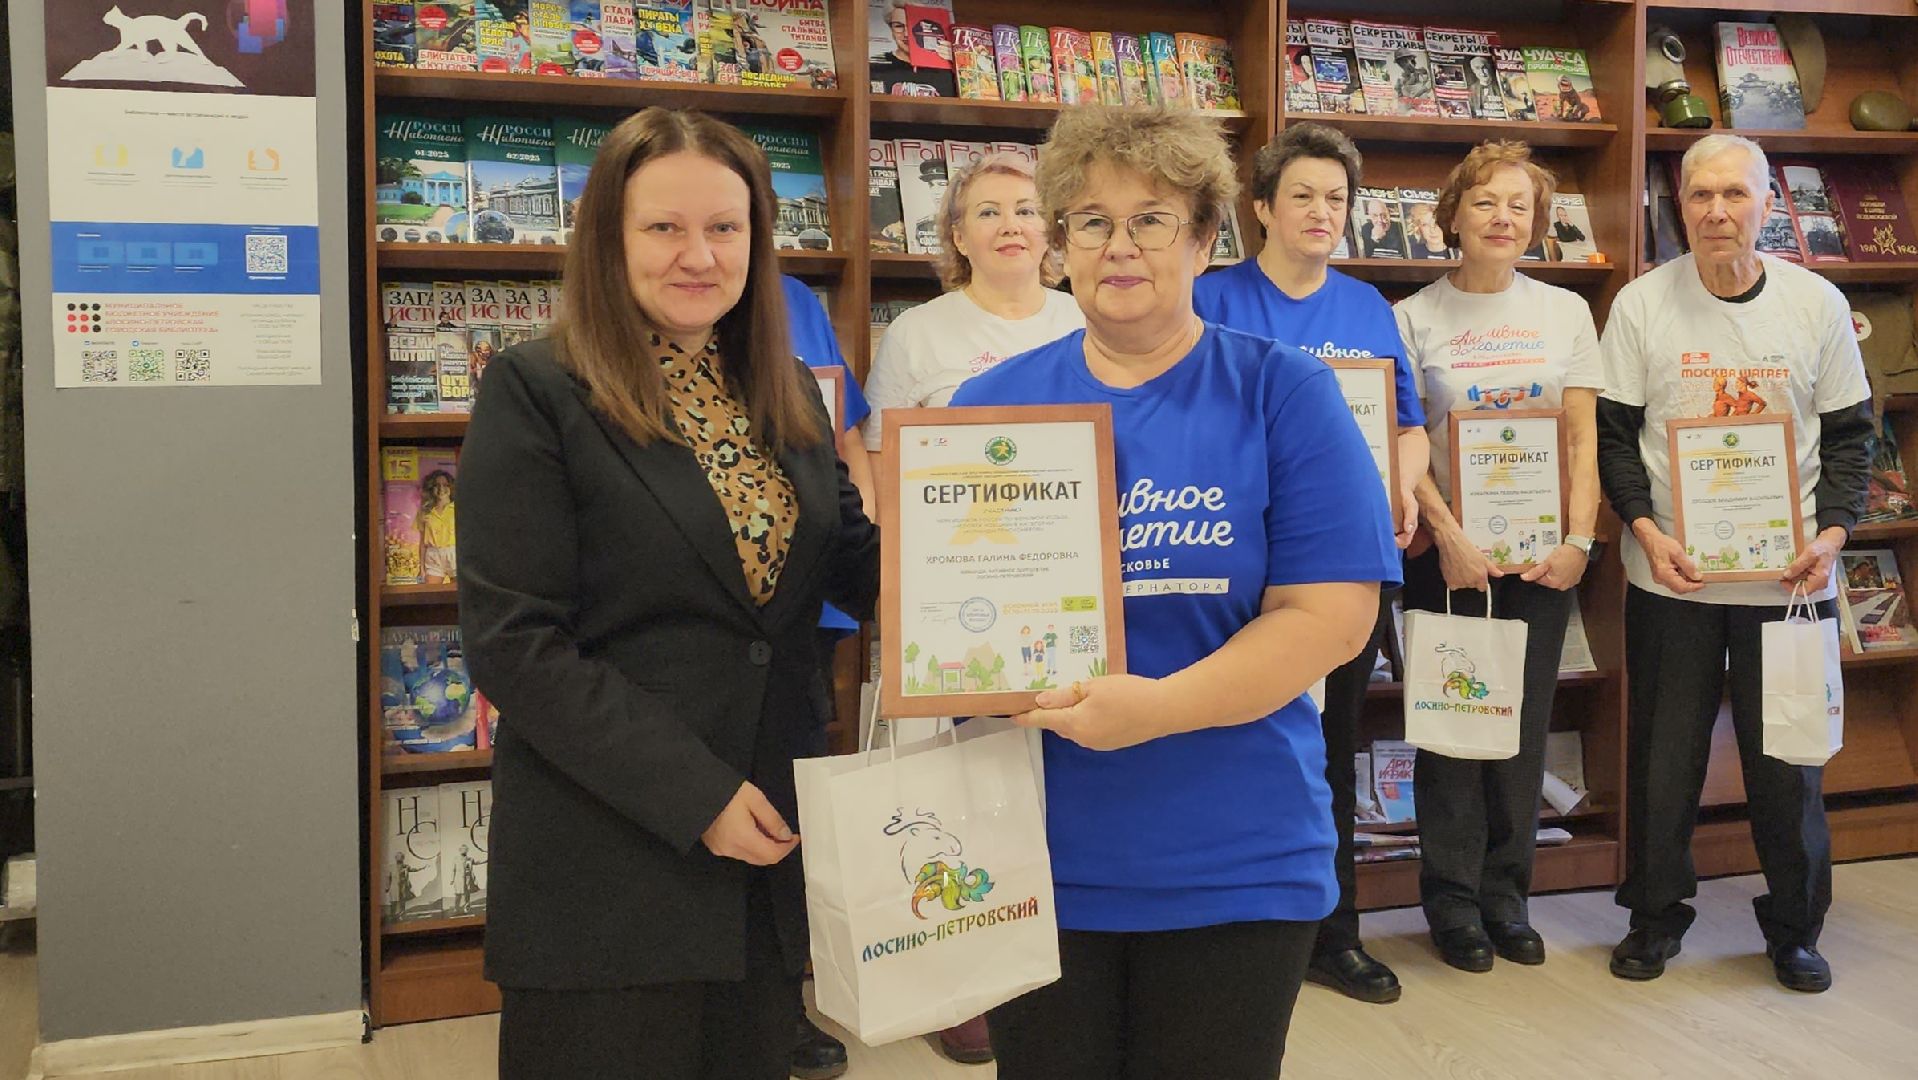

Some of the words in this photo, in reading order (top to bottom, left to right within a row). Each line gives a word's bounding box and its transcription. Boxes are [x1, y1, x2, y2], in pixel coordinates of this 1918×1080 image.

[639, 9, 679, 21] ПИРАТЫ
[655, 21, 682, 33] ВЕКА
[781, 25, 827, 34] СТАЛЬНЫХ
[799, 19, 826, 27] БИТВА
[791, 33, 828, 42] ТИТАНОВ
[1307, 24, 1350, 37] СЕКРЕТ
[1353, 26, 1406, 40] СЕКРЕТЫ
[1381, 40, 1426, 50] АРХИВЫ
[1425, 32, 1475, 44] СЕКРЕТЫ
[375, 51, 405, 61] ОХОТА
[420, 51, 478, 63] БЛИСТАТЕЛЬ
[1524, 49, 1585, 64] ЧУДЕСА
[440, 290, 465, 306] ЗА
[472, 287, 497, 304] ЗА
[506, 289, 531, 305] ЗА
[538, 287, 551, 303] З
[470, 303, 499, 320] ИС
[505, 304, 532, 320] ИС
[1681, 368, 1736, 378] МОСКВА
[1739, 368, 1790, 379] ШАГАЕТ
[1470, 451, 1550, 466] СЕРТИФИКАТ
[1690, 455, 1777, 471] СЕРТИФИКАТ
[923, 481, 1082, 504] СЕРТИФИКАТ
[978, 554, 1016, 562] ГАЛИНА
[1414, 701, 1513, 718] ЛОСИНО-ПЕТРОВСКИЙ
[862, 896, 1040, 963] ЛОСИНО-ПЕТРОВСКИЙ
